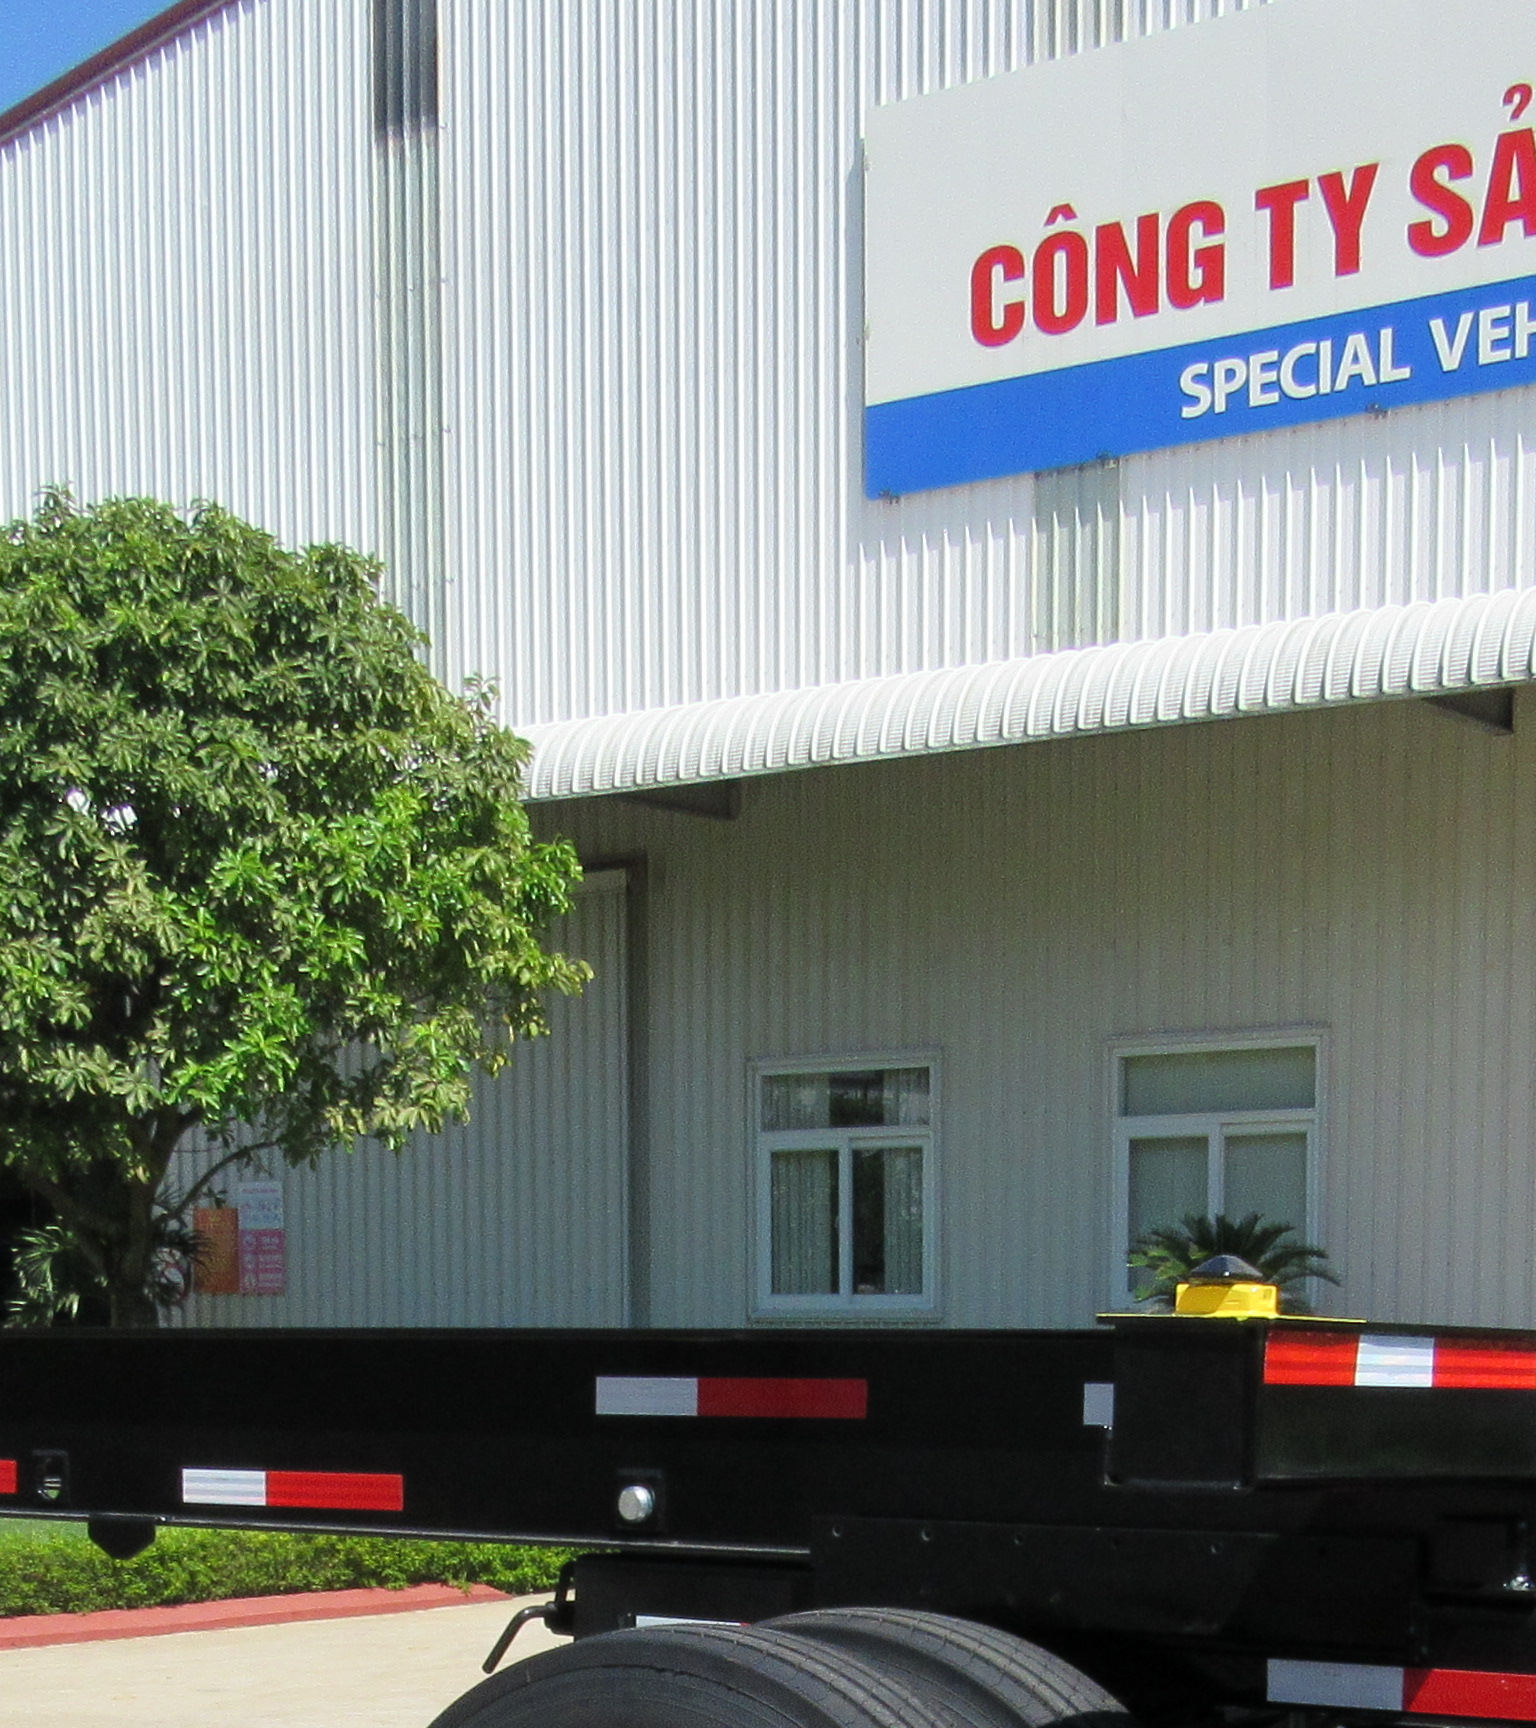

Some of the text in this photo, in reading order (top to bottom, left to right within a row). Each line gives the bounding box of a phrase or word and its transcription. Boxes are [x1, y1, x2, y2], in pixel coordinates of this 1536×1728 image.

[971, 203, 1226, 348] CÔNG
[1256, 163, 1379, 290] TY
[1179, 327, 1413, 419] SPECIAL
